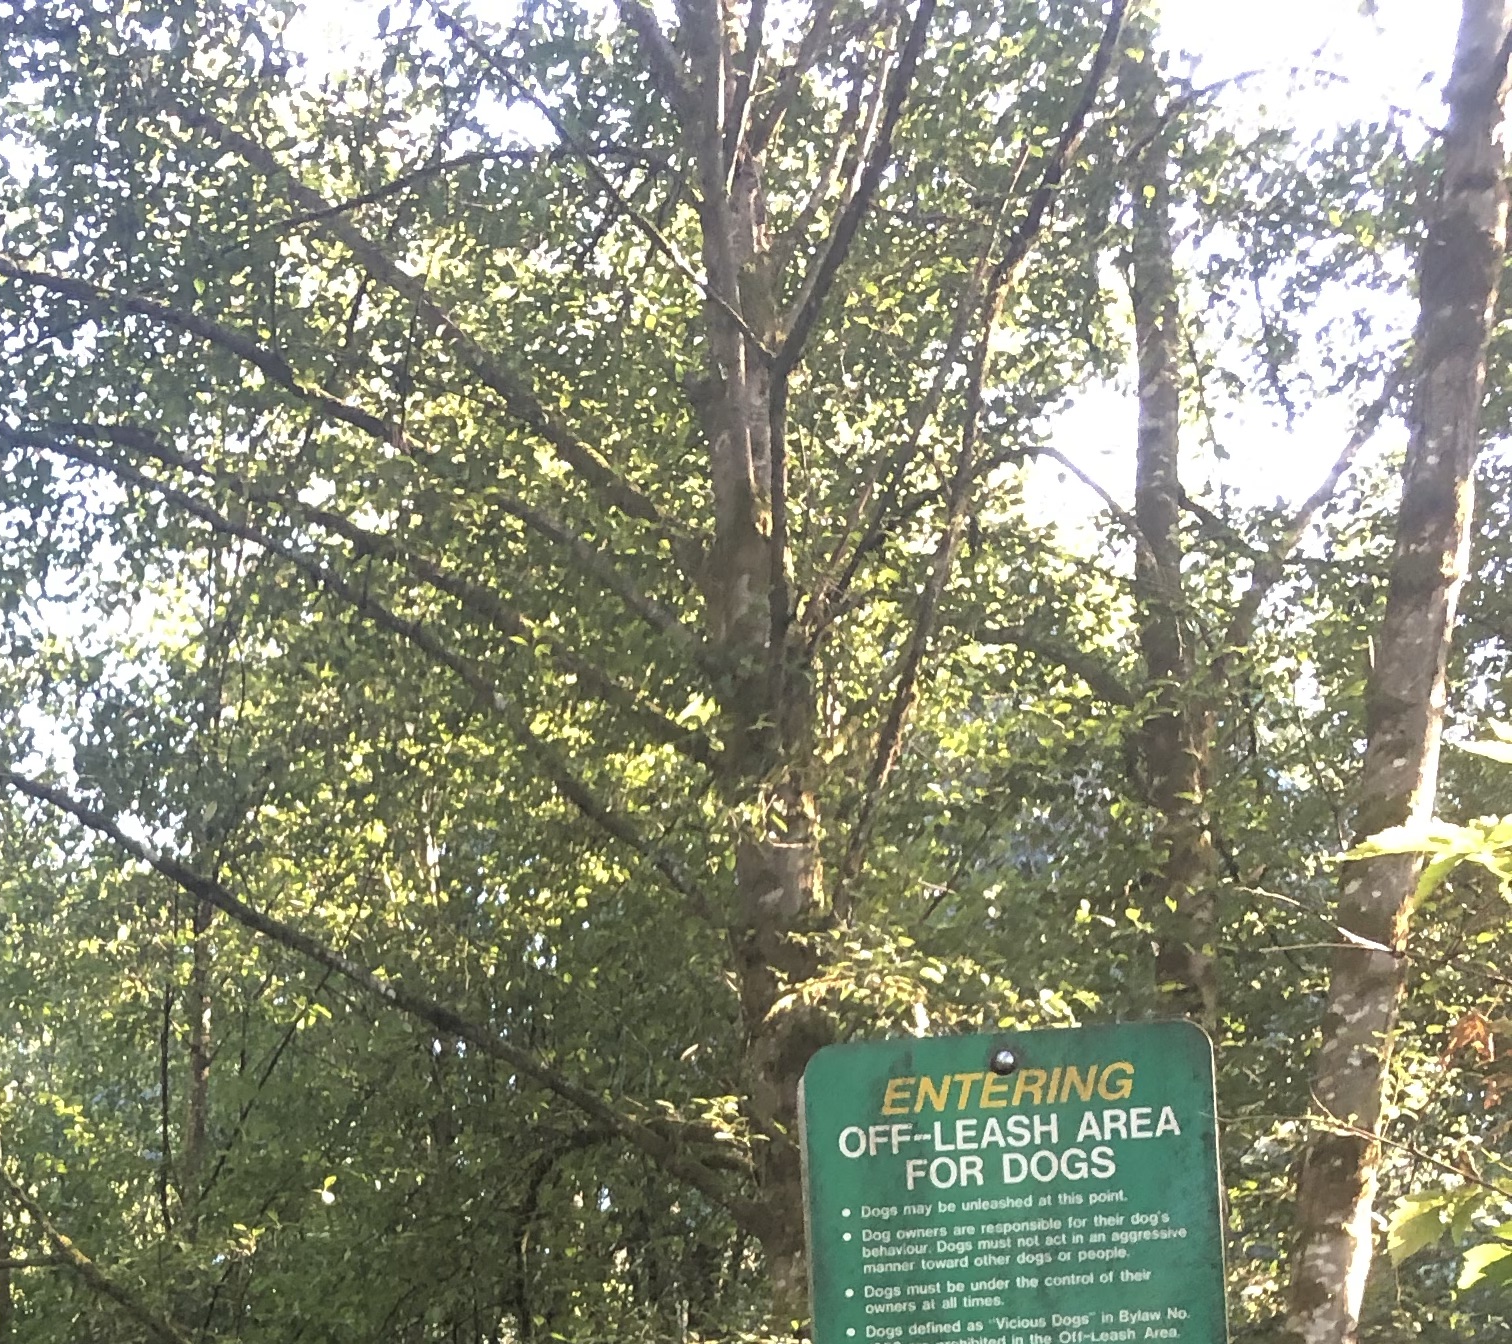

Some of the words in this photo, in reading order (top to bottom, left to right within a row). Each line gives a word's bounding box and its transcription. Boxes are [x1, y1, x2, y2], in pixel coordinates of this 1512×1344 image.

[881, 1062, 1135, 1115] ENTERING
[839, 1113, 1058, 1158] OFF-LEASH
[1077, 1106, 1181, 1142] AREA
[906, 1155, 983, 1190] FOR
[1003, 1146, 1115, 1184] DOGS
[861, 1206, 898, 1219] Dogs
[904, 1204, 932, 1216] may
[938, 1201, 956, 1213] be
[962, 1196, 1033, 1212] unleashed
[1039, 1195, 1051, 1206] at
[1058, 1192, 1083, 1205] this
[1089, 1189, 1128, 1205] point.
[862, 1229, 890, 1242] Dog
[897, 1227, 947, 1239] owners
[954, 1225, 975, 1235] are
[981, 1218, 1062, 1236] responsible
[1068, 1217, 1087, 1228] for
[1094, 1213, 1125, 1227] their
[1131, 1211, 1170, 1226] dog's
[862, 1244, 932, 1258] behaviour.
[937, 1240, 972, 1253] Dogs
[978, 1237, 1011, 1249] must
[1018, 1235, 1040, 1247] not
[1046, 1233, 1066, 1245] act
[1072, 1232, 1084, 1243] in
[1090, 1232, 1106, 1243] an
[1112, 1227, 1187, 1243] aggressive
[864, 1262, 915, 1273] manner
[921, 1256, 969, 1269] toward
[974, 1254, 1010, 1267] other
[1017, 1252, 1052, 1265] dogs
[1058, 1251, 1071, 1261] or
[1078, 1247, 1130, 1262] people.
[864, 1285, 901, 1299] Dogs
[907, 1282, 941, 1295] must
[947, 1280, 965, 1293] be
[971, 1277, 1010, 1291] under
[1016, 1276, 1039, 1288] the
[1044, 1272, 1094, 1287] control
[1100, 1271, 1115, 1283] of
[1120, 1269, 1152, 1282] their
[865, 1301, 916, 1314] owners
[922, 1299, 935, 1311] at
[941, 1296, 958, 1309] all
[963, 1295, 1005, 1308] times.
[865, 1325, 903, 1339] Dogs
[909, 1321, 961, 1335] defined
[967, 1321, 984, 1333] as
[1101, 1311, 1114, 1324] in
[1119, 1308, 1161, 1324] Bylaw
[1167, 1308, 1191, 1321] No.
[1059, 1329, 1136, 1344] Off-Leash
[1144, 1328, 1181, 1340] Area.
